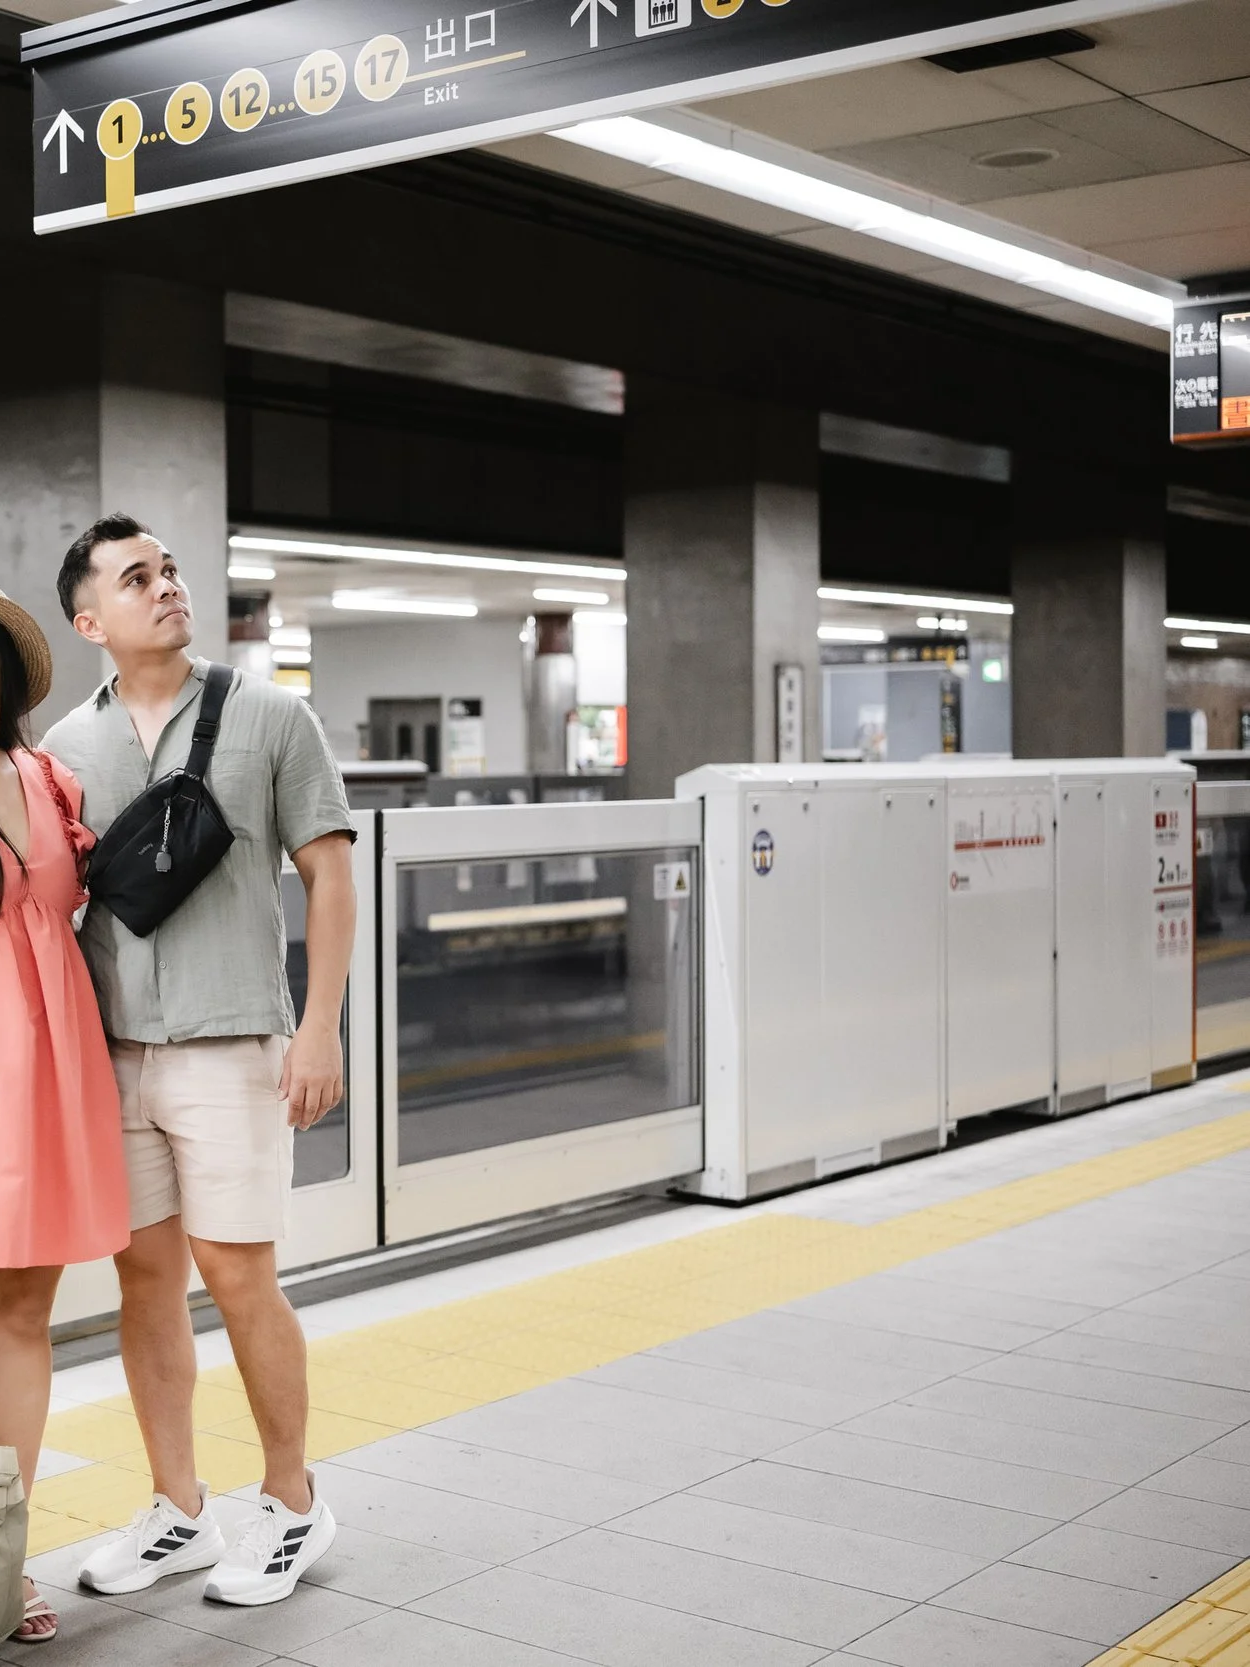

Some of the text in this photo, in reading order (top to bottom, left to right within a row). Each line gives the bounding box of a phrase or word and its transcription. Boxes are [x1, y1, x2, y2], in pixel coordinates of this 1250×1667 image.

[424, 9, 495, 63] 出口
[112, 48, 400, 144] 1 5 12 15 17
[424, 83, 459, 105] Exit
